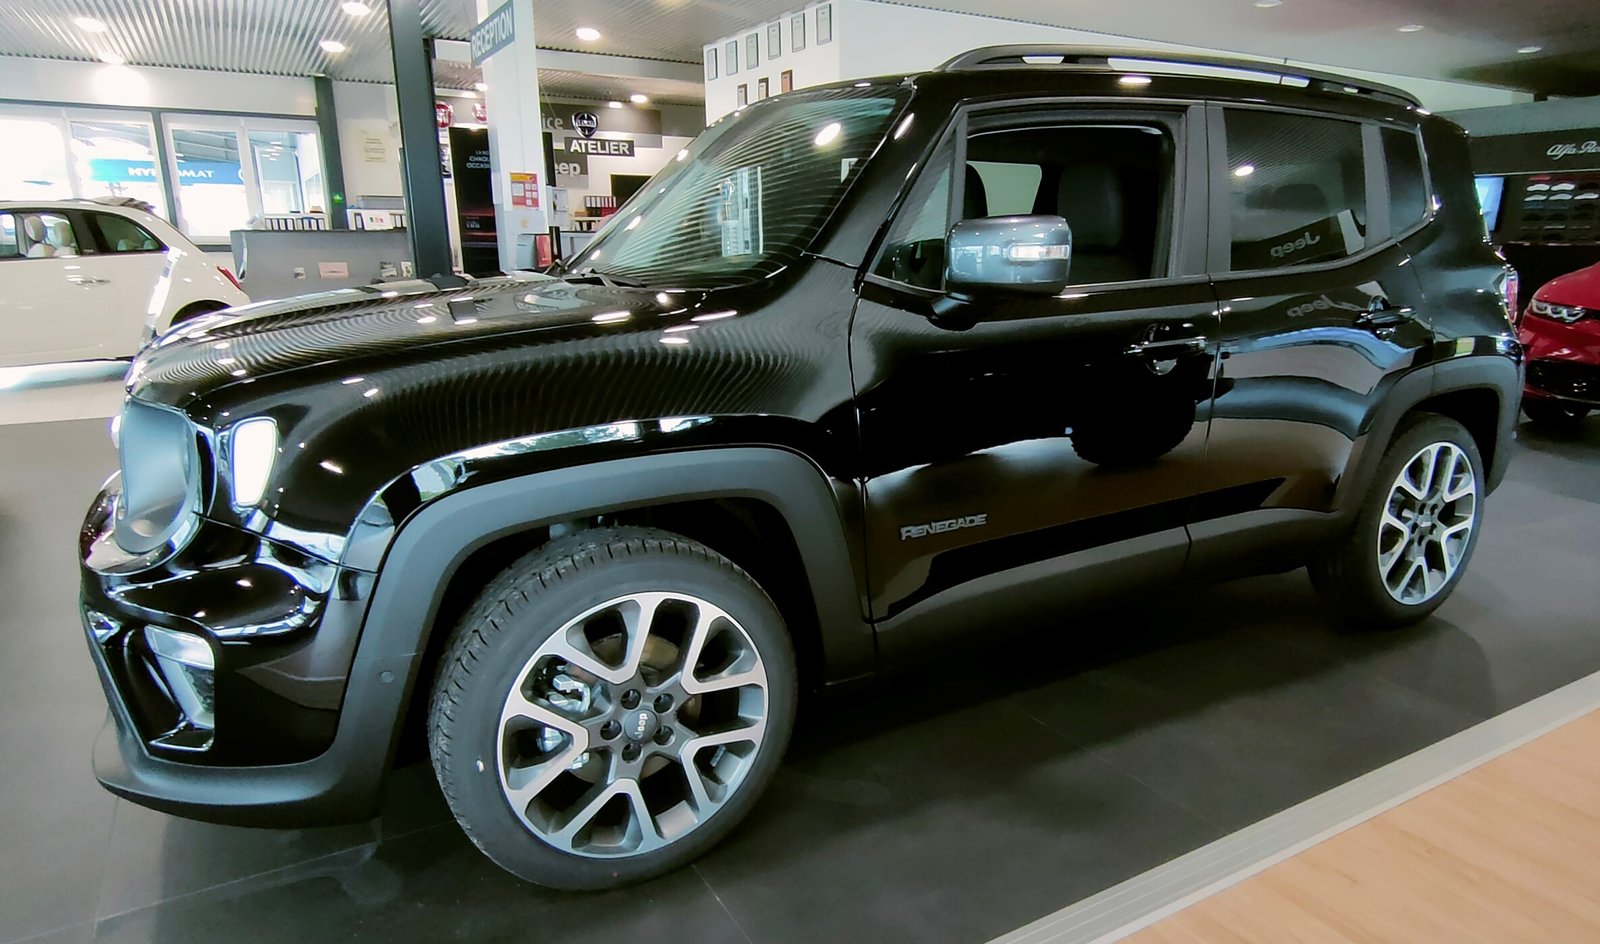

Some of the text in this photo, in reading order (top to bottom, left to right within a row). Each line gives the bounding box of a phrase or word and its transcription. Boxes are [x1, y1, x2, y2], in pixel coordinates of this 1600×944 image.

[471, 6, 513, 59] RECEPTION
[570, 139, 630, 155] ATELIER
[1546, 143, 1577, 160] Alfa
[900, 513, 987, 541] RENEGADE
[634, 713, 649, 739] Jeep
